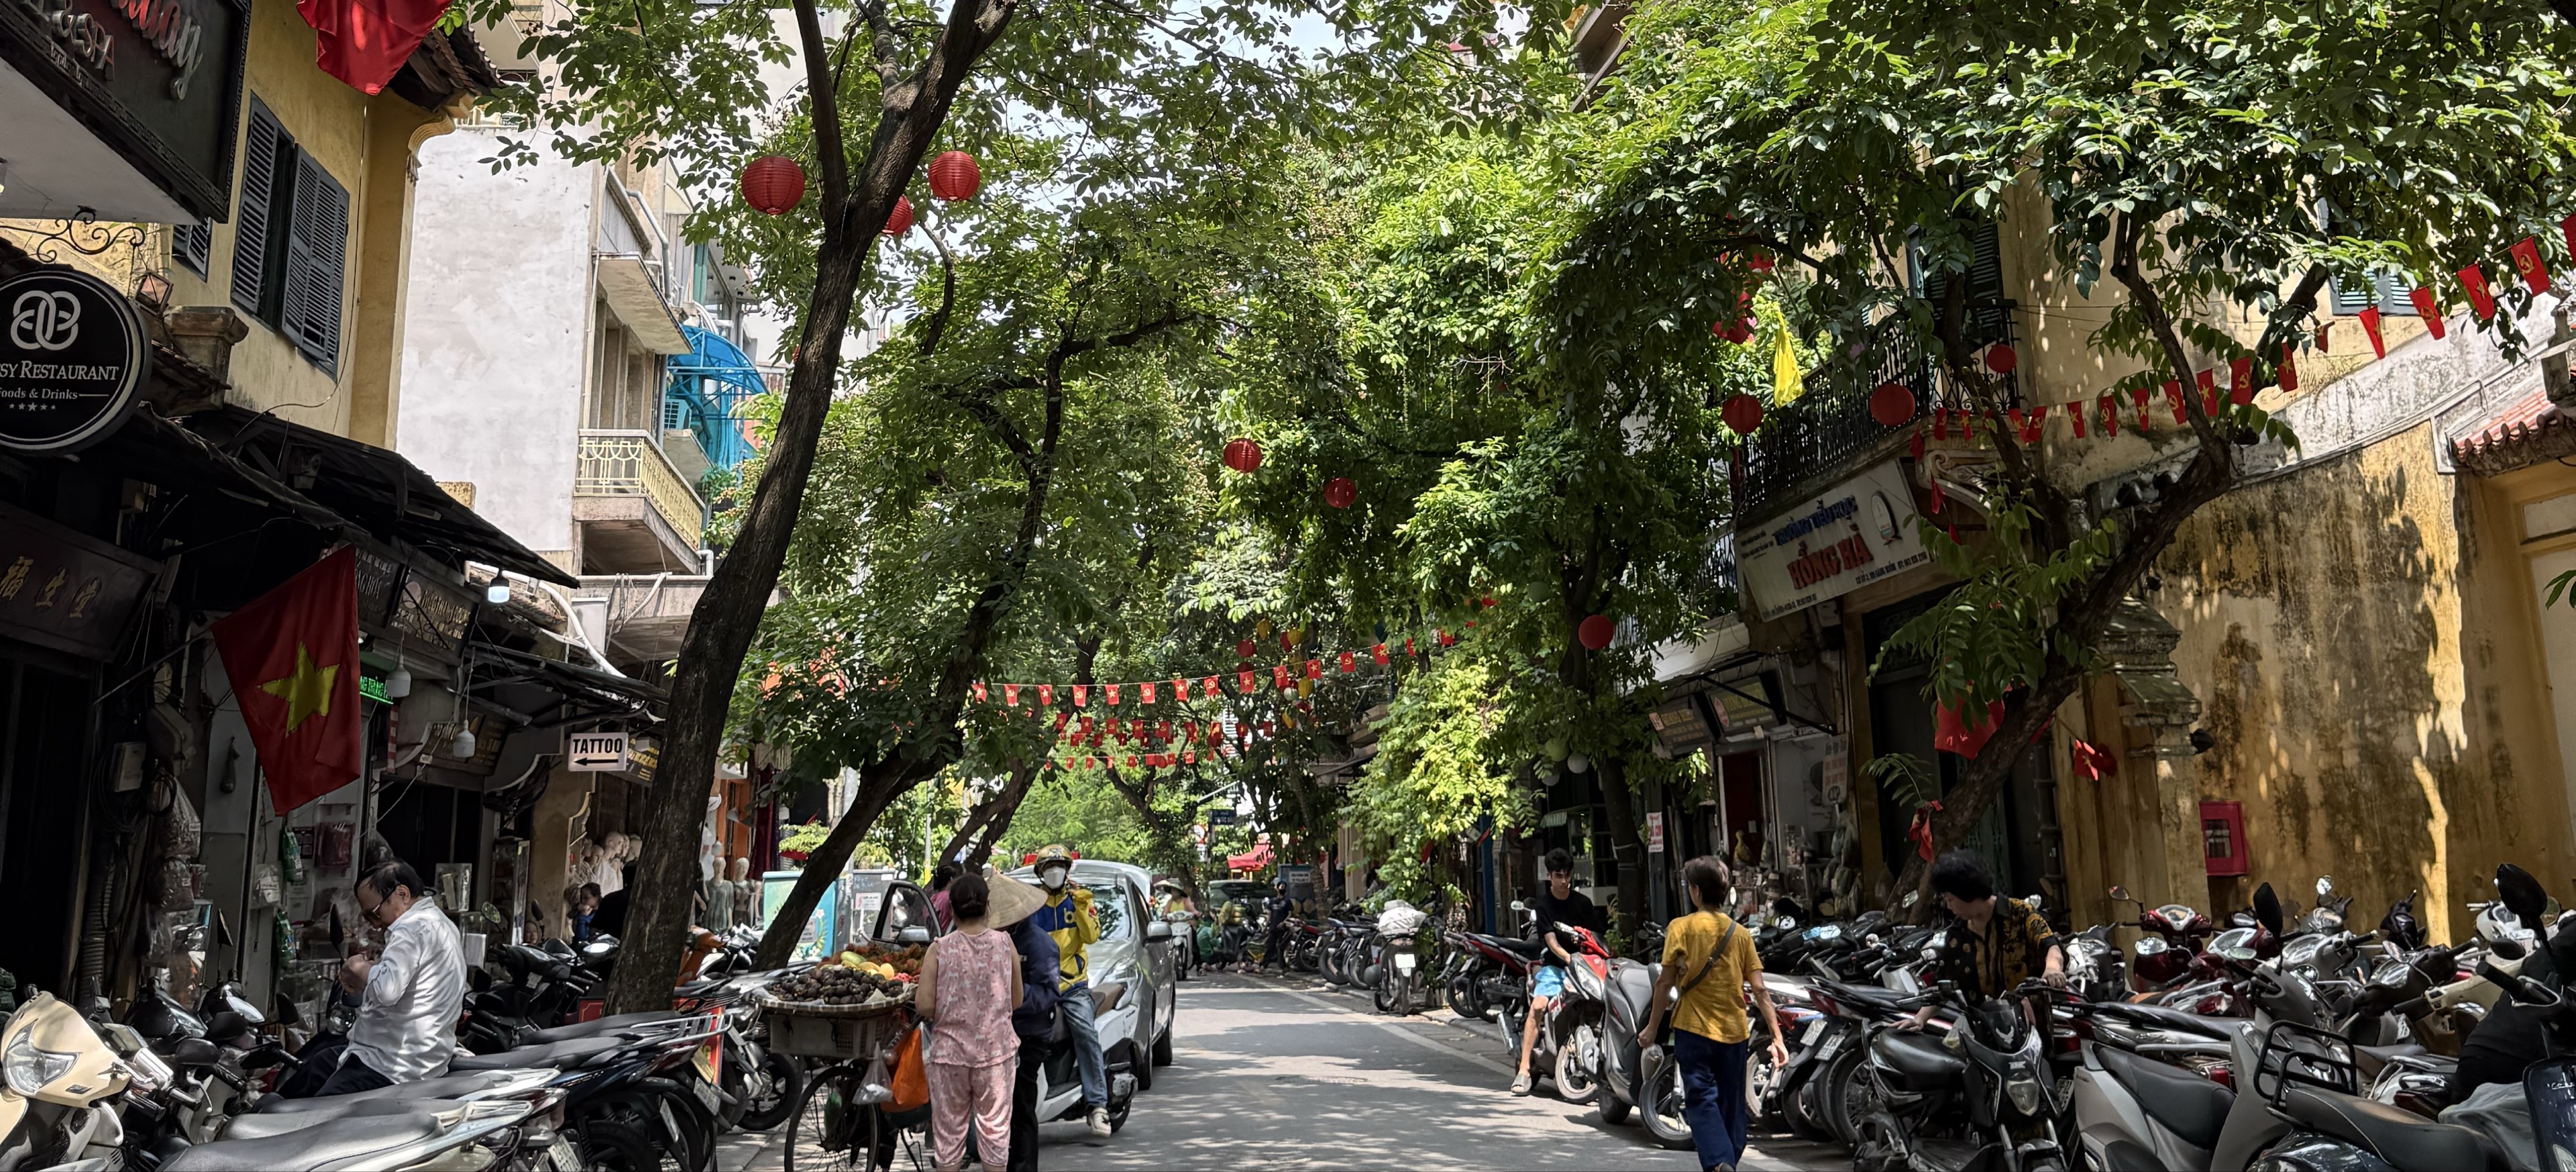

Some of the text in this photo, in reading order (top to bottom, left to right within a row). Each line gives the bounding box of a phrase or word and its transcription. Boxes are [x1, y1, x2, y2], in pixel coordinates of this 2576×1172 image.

[74, 13, 115, 81] SPA
[19, 360, 119, 380] RESTAURANT
[29, 388, 38, 398] &
[42, 388, 78, 399] Drinks
[1787, 540, 1841, 590] HỒNG
[1837, 523, 1874, 570] HÀ
[573, 738, 623, 753] TATTOO
